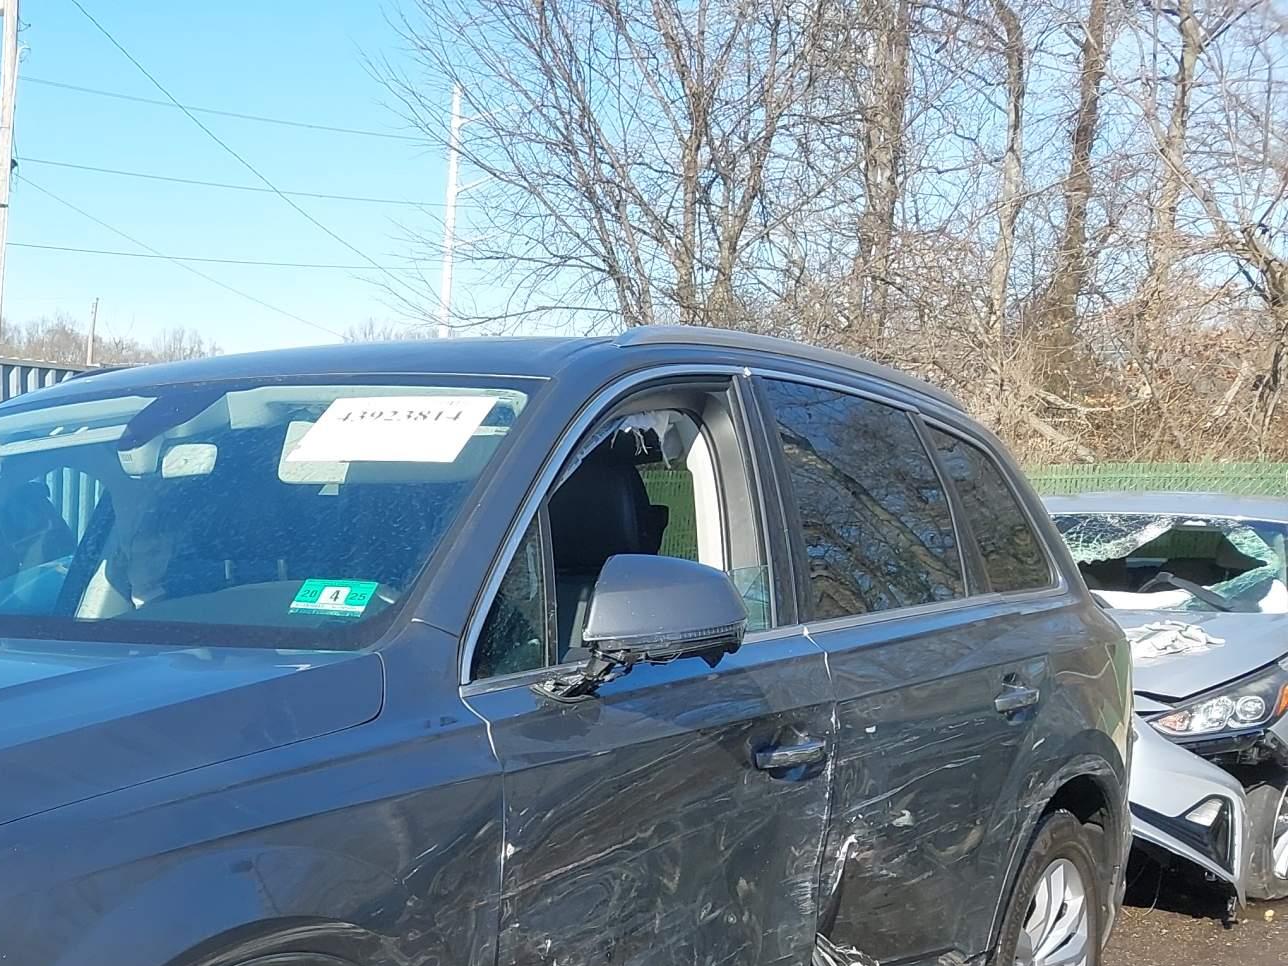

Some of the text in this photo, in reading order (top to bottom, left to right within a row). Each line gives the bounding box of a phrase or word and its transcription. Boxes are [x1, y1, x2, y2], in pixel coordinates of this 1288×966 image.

[302, 589, 367, 602] 20 4 25
